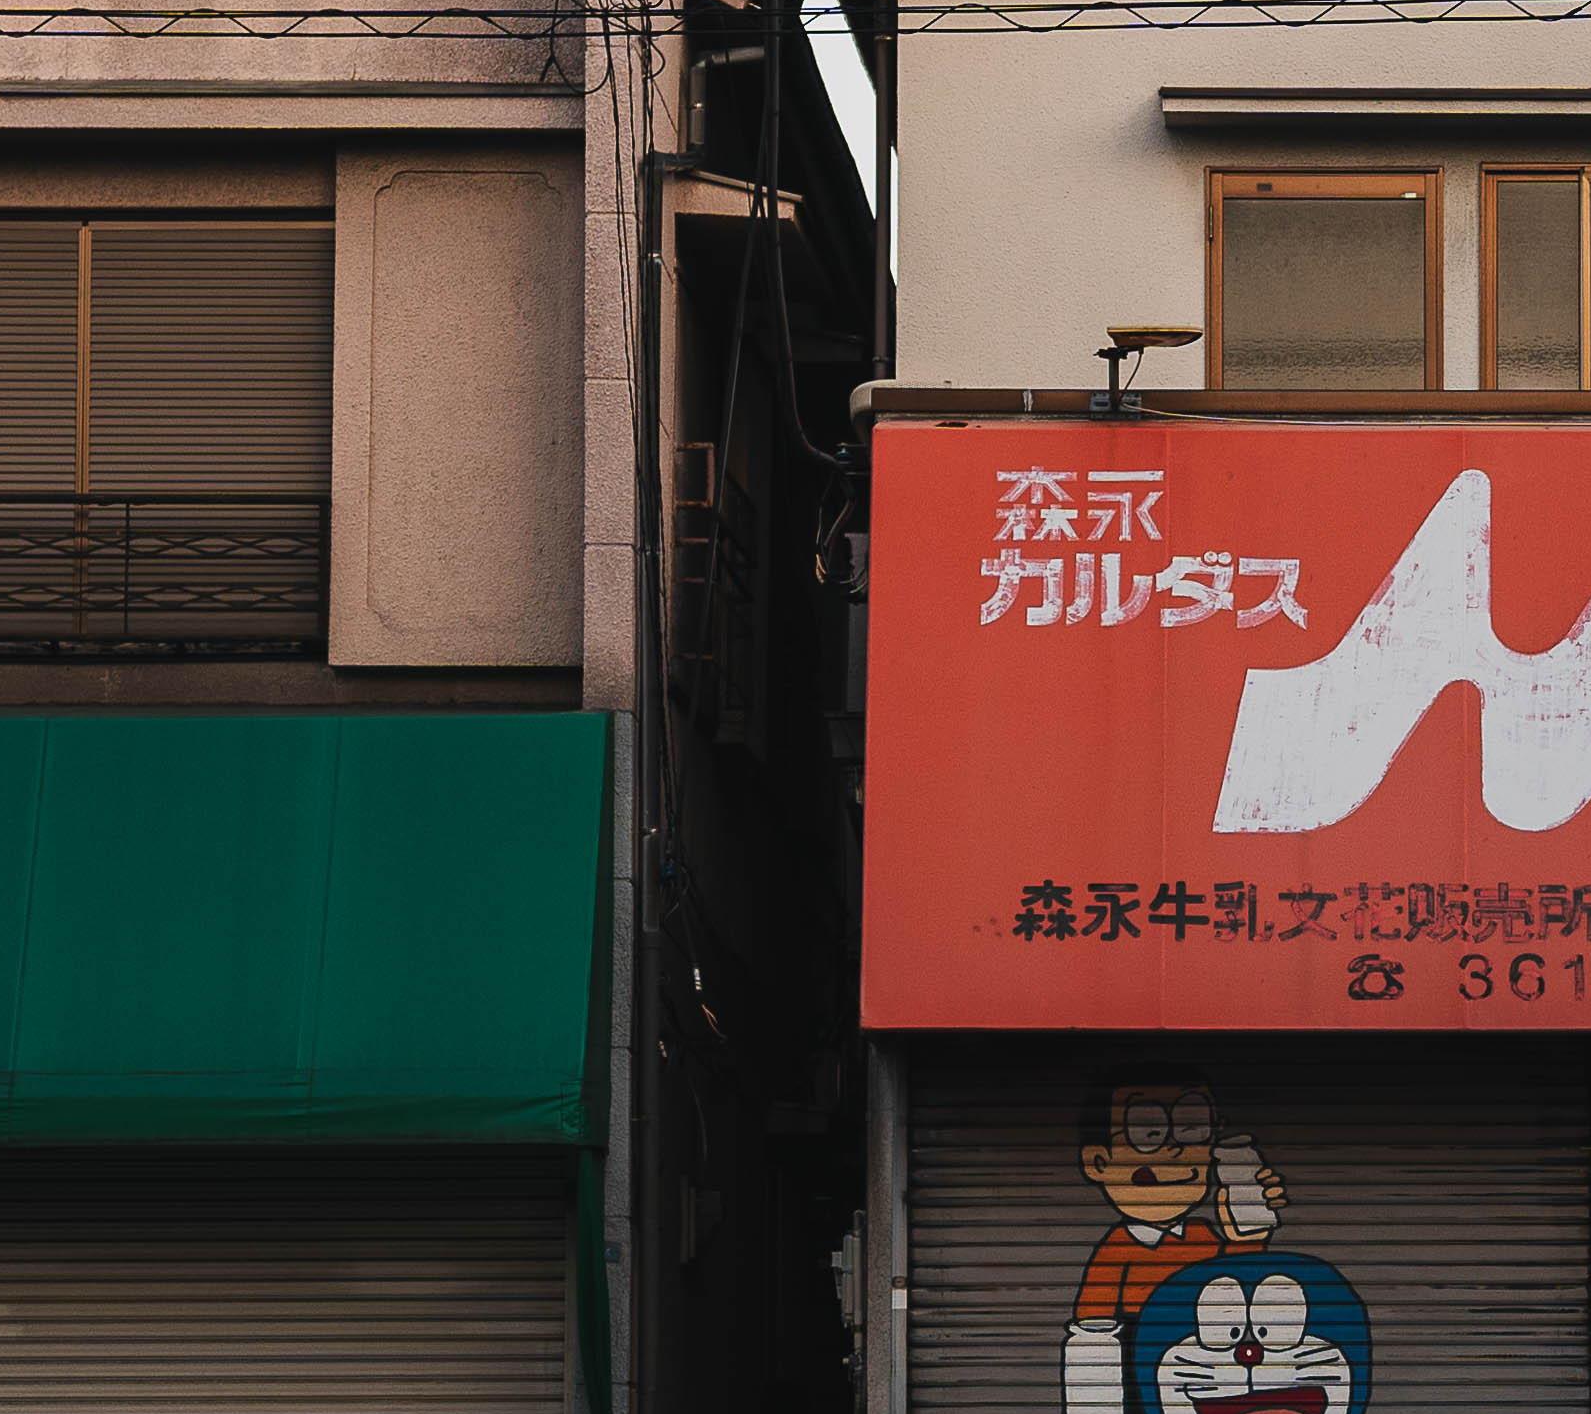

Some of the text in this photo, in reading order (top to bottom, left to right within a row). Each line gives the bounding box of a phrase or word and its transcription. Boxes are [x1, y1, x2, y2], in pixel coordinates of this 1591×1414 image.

[993, 465, 1166, 542] 森永
[980, 548, 1309, 631] カルダス
